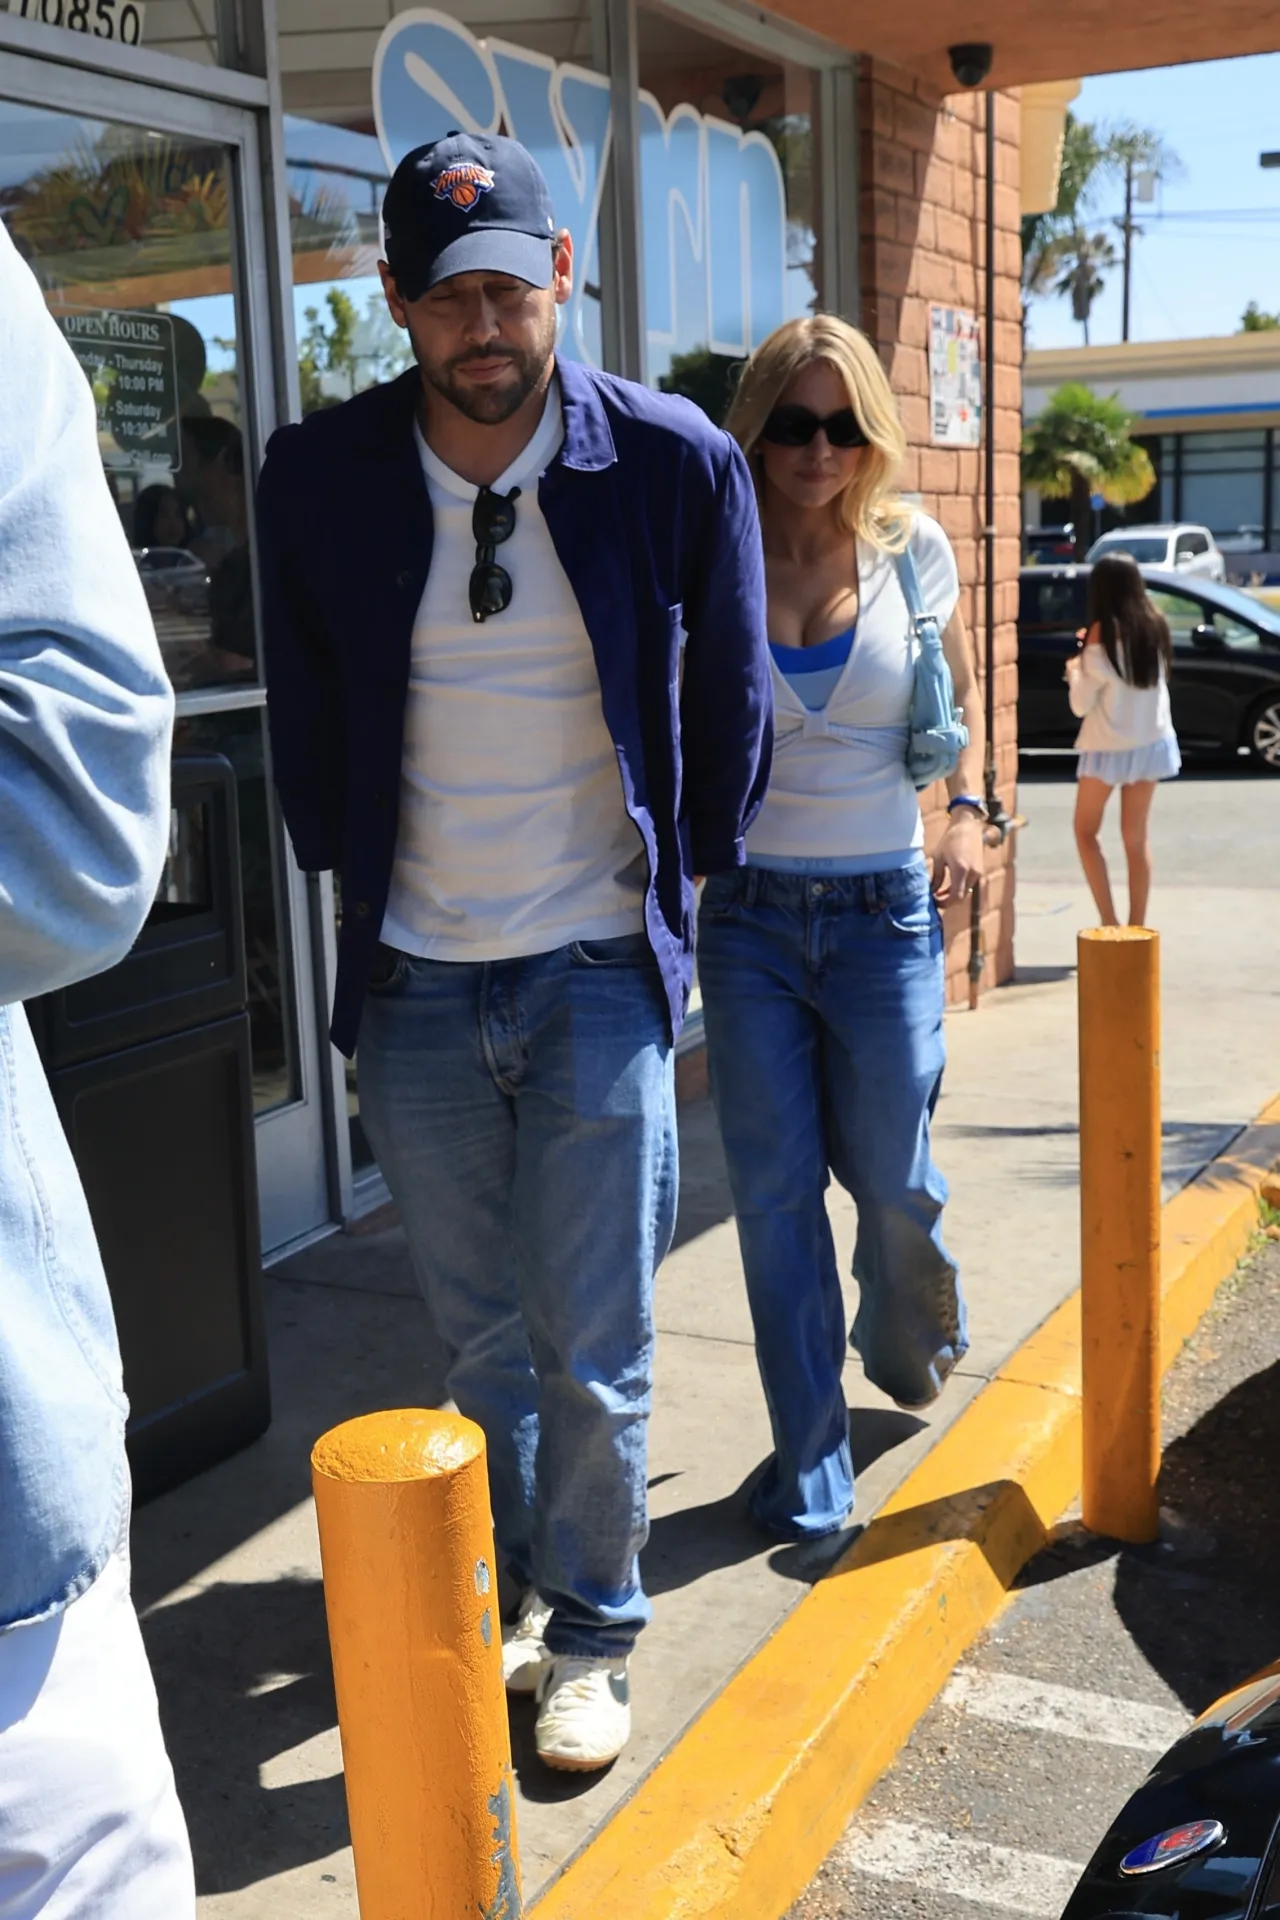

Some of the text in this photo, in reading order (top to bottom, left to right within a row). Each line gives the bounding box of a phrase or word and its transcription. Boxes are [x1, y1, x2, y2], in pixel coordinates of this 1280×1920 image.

[64, 316, 159, 341] OPEN HOURS
[77, 351, 105, 368] nday
[114, 353, 163, 375] Thursday
[119, 375, 145, 391] 10:00
[148, 377, 164, 392] PM
[116, 400, 161, 420] Saturday
